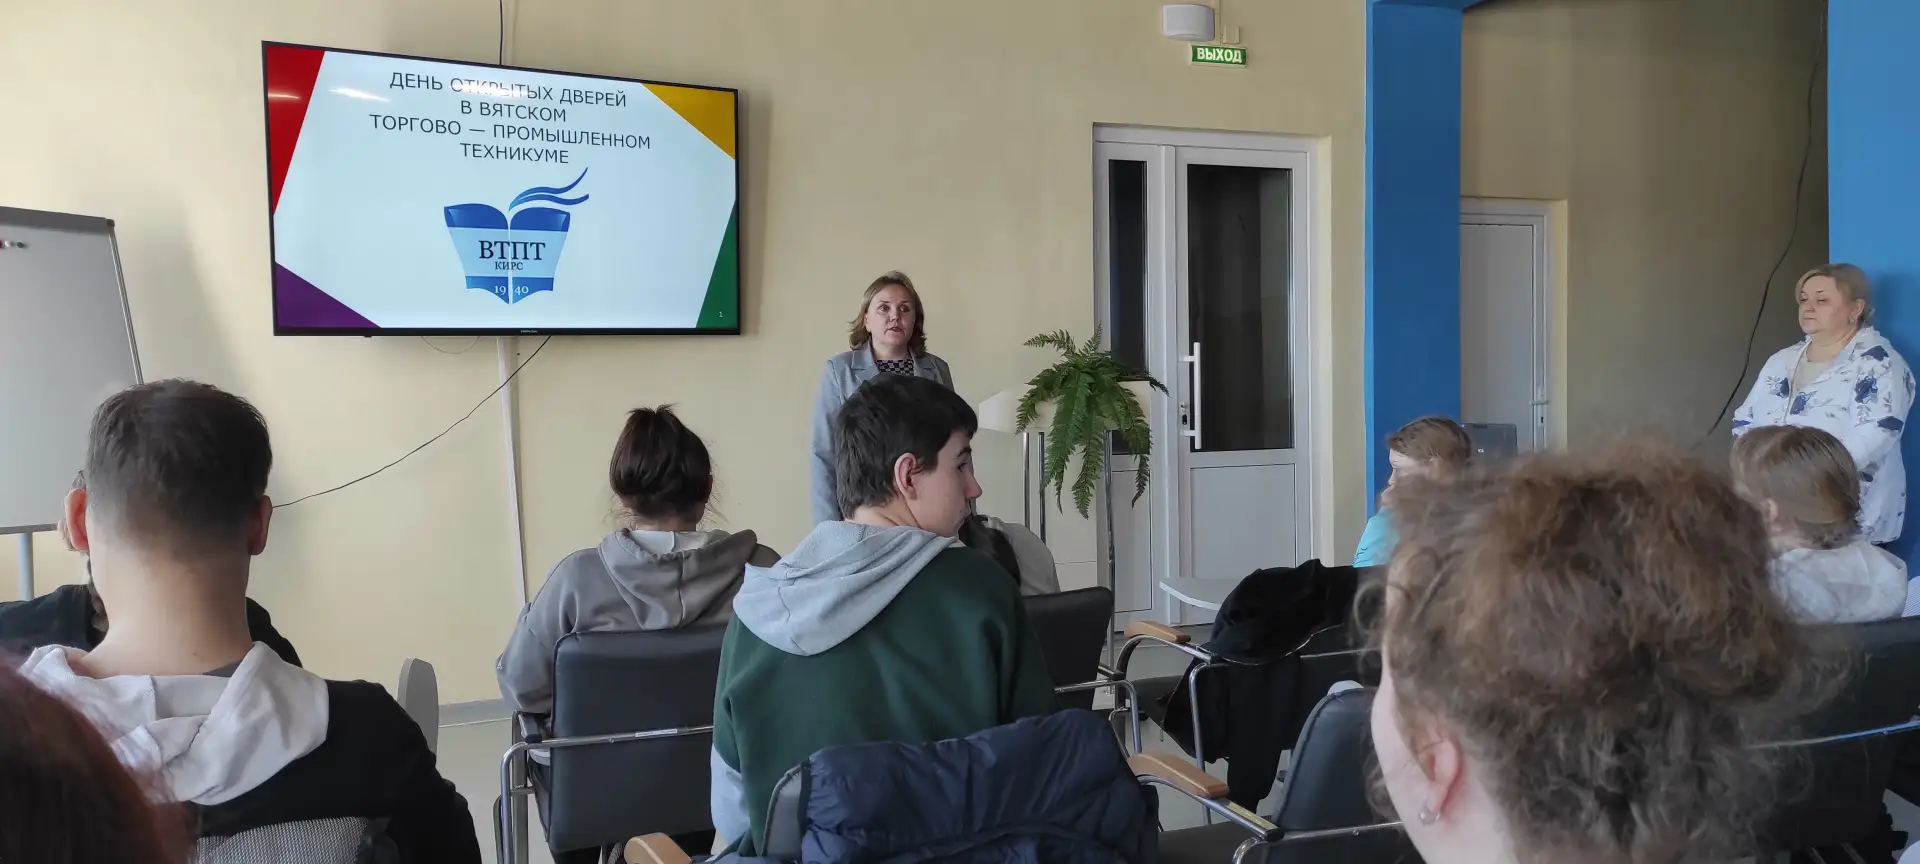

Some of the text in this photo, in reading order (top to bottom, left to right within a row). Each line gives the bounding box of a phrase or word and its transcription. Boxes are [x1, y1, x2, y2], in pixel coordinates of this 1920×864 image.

[1197, 47, 1242, 63] ВЫХОД
[390, 72, 627, 108] ДЕНЬ ОТКРЫТЫХ ДВЕРЕЙ
[460, 100, 567, 123] В ВЯТСКОМ
[369, 114, 462, 136] ТОРГОВО
[493, 124, 651, 150] ПРОМЫШЛЕННОМ
[460, 142, 570, 165] ТЕХНИКУМЕ
[478, 240, 546, 260] ВТПТ
[494, 261, 524, 271] КИРС
